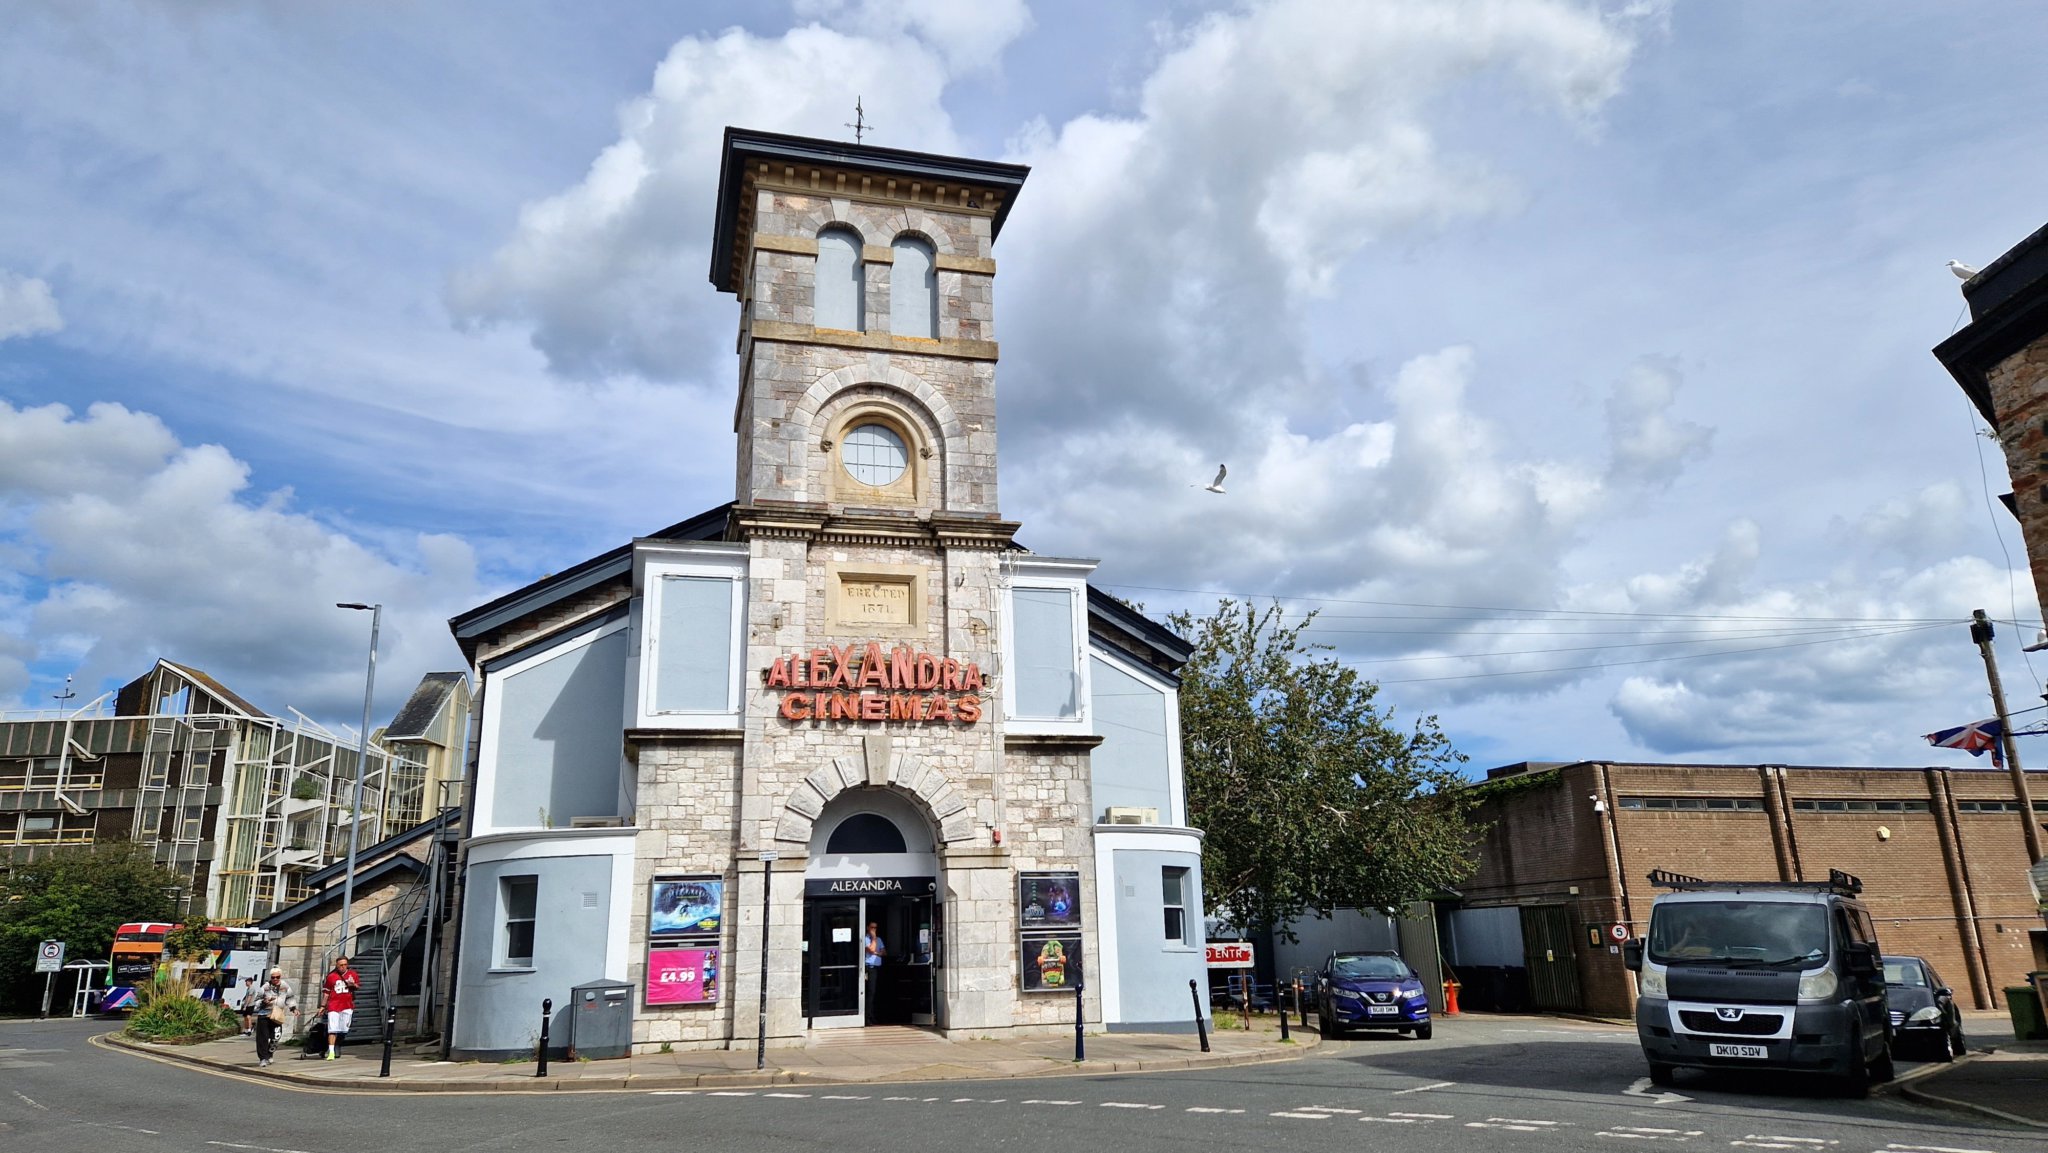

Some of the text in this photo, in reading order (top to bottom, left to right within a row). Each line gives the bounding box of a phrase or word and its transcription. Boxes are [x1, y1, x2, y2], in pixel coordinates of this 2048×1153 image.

[847, 587, 905, 599] ERECTED
[767, 641, 983, 691] ALEXANDRA
[781, 693, 982, 722] CINEMAS
[830, 880, 902, 892] ALEXANDRA
[1615, 927, 1623, 937] 5
[660, 971, 696, 983] £4.99
[1716, 1045, 1761, 1057] DK10 SDV
